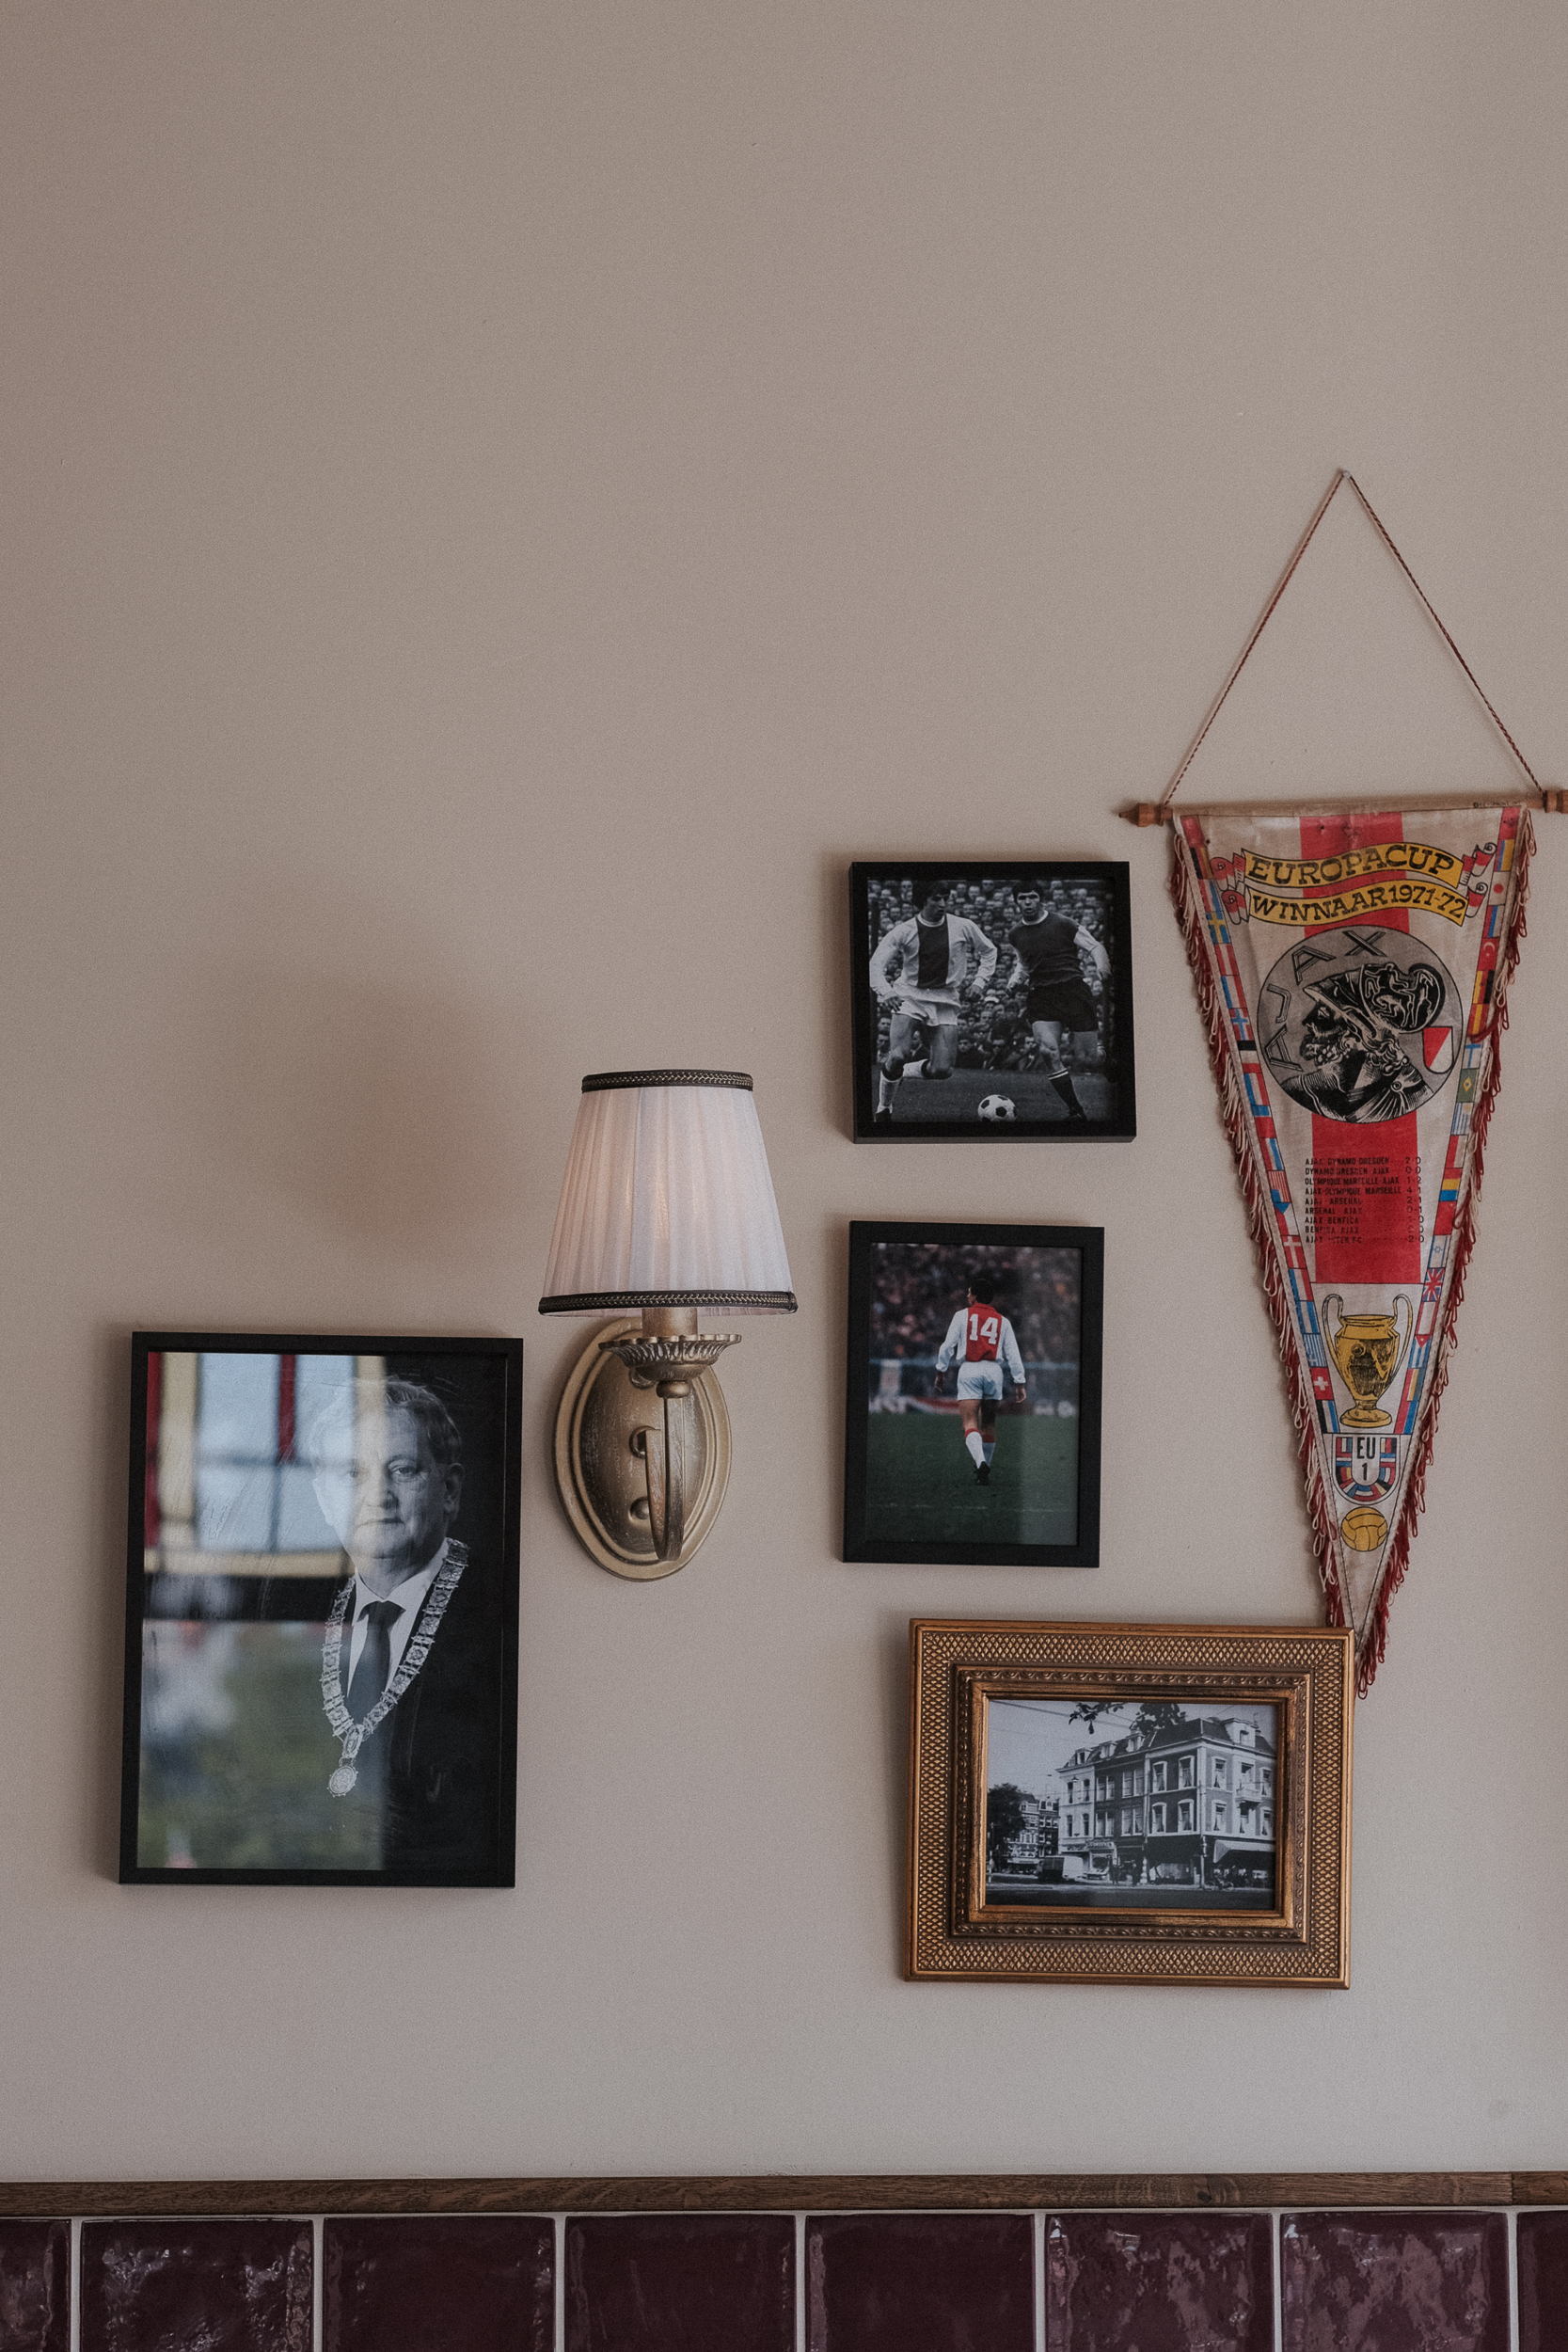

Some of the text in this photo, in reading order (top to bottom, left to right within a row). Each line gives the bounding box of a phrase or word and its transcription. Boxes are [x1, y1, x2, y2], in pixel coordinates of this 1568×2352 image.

[1248, 844, 1454, 885] EUROPACUP
[1252, 884, 1466, 921] WINNAAR 1971-72
[1264, 930, 1387, 1072] AJAX
[1327, 1157, 1356, 1166] DYNAMO
[1372, 1167, 1389, 1175] AJAX
[1382, 1176, 1400, 1184] AJAX
[1365, 1186, 1402, 1195] MARSEILLE
[969, 1313, 999, 1345] 14
[1356, 1437, 1376, 1459] EU
[1362, 1463, 1368, 1481] 1
